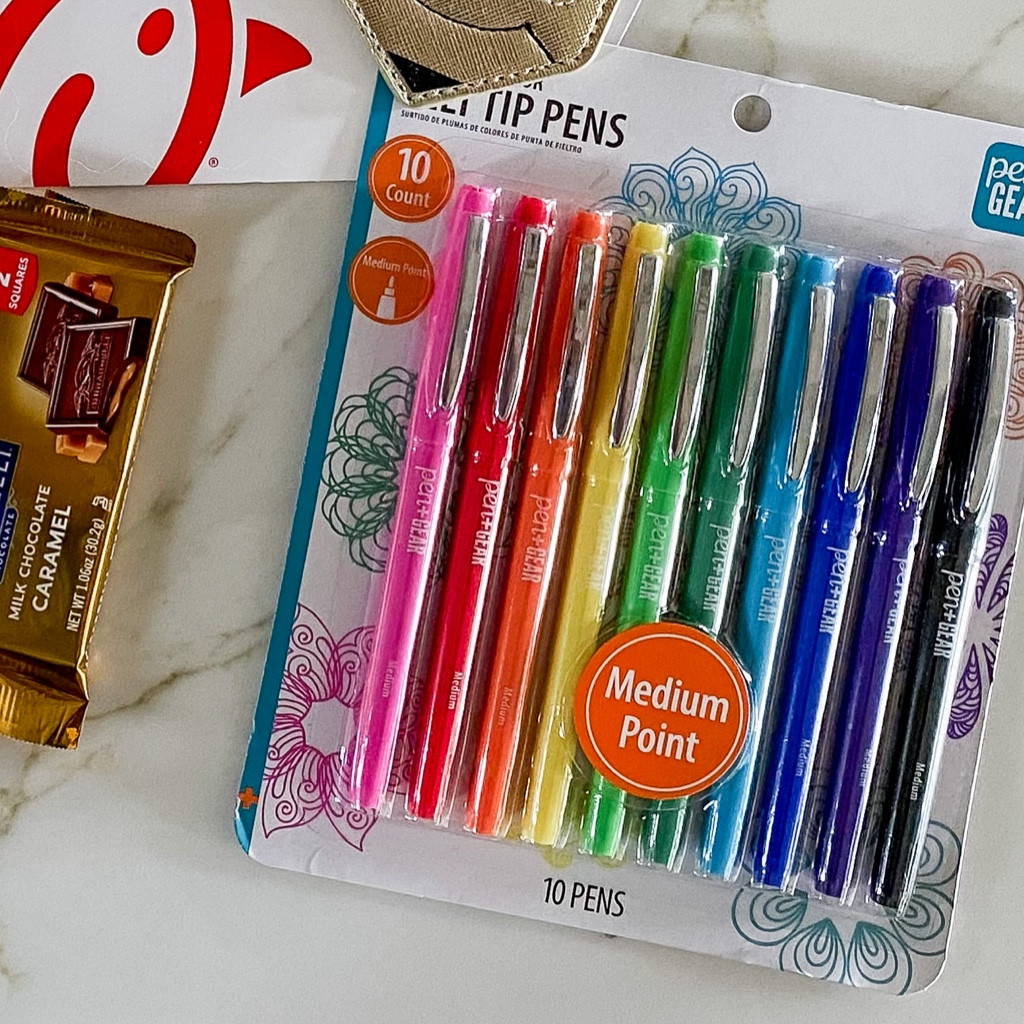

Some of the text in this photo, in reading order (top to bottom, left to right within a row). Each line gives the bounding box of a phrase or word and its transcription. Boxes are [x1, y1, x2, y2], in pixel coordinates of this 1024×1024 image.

[400, 110, 583, 154] SURTIDO DE PLUMAS DE COLORES DE PUNTA DE FIELTRO
[484, 90, 534, 128] TIP
[540, 99, 628, 149] PENS
[398, 147, 431, 185] 10
[386, 183, 431, 208] Count
[8, 257, 29, 310] SQUARES
[362, 255, 428, 277] Medium Point
[8, 484, 51, 621] MILK CHOCOLATE
[31, 504, 72, 613] CARAMEL
[66, 518, 105, 632] NET WT 1.06oz (30.2g)
[447, 671, 463, 710] Medium
[497, 686, 514, 726] Medium
[604, 665, 730, 724] Medium
[618, 714, 700, 764] Point
[795, 738, 811, 777] Medium
[910, 761, 926, 801] Medium
[543, 877, 626, 918] 10 PENS
